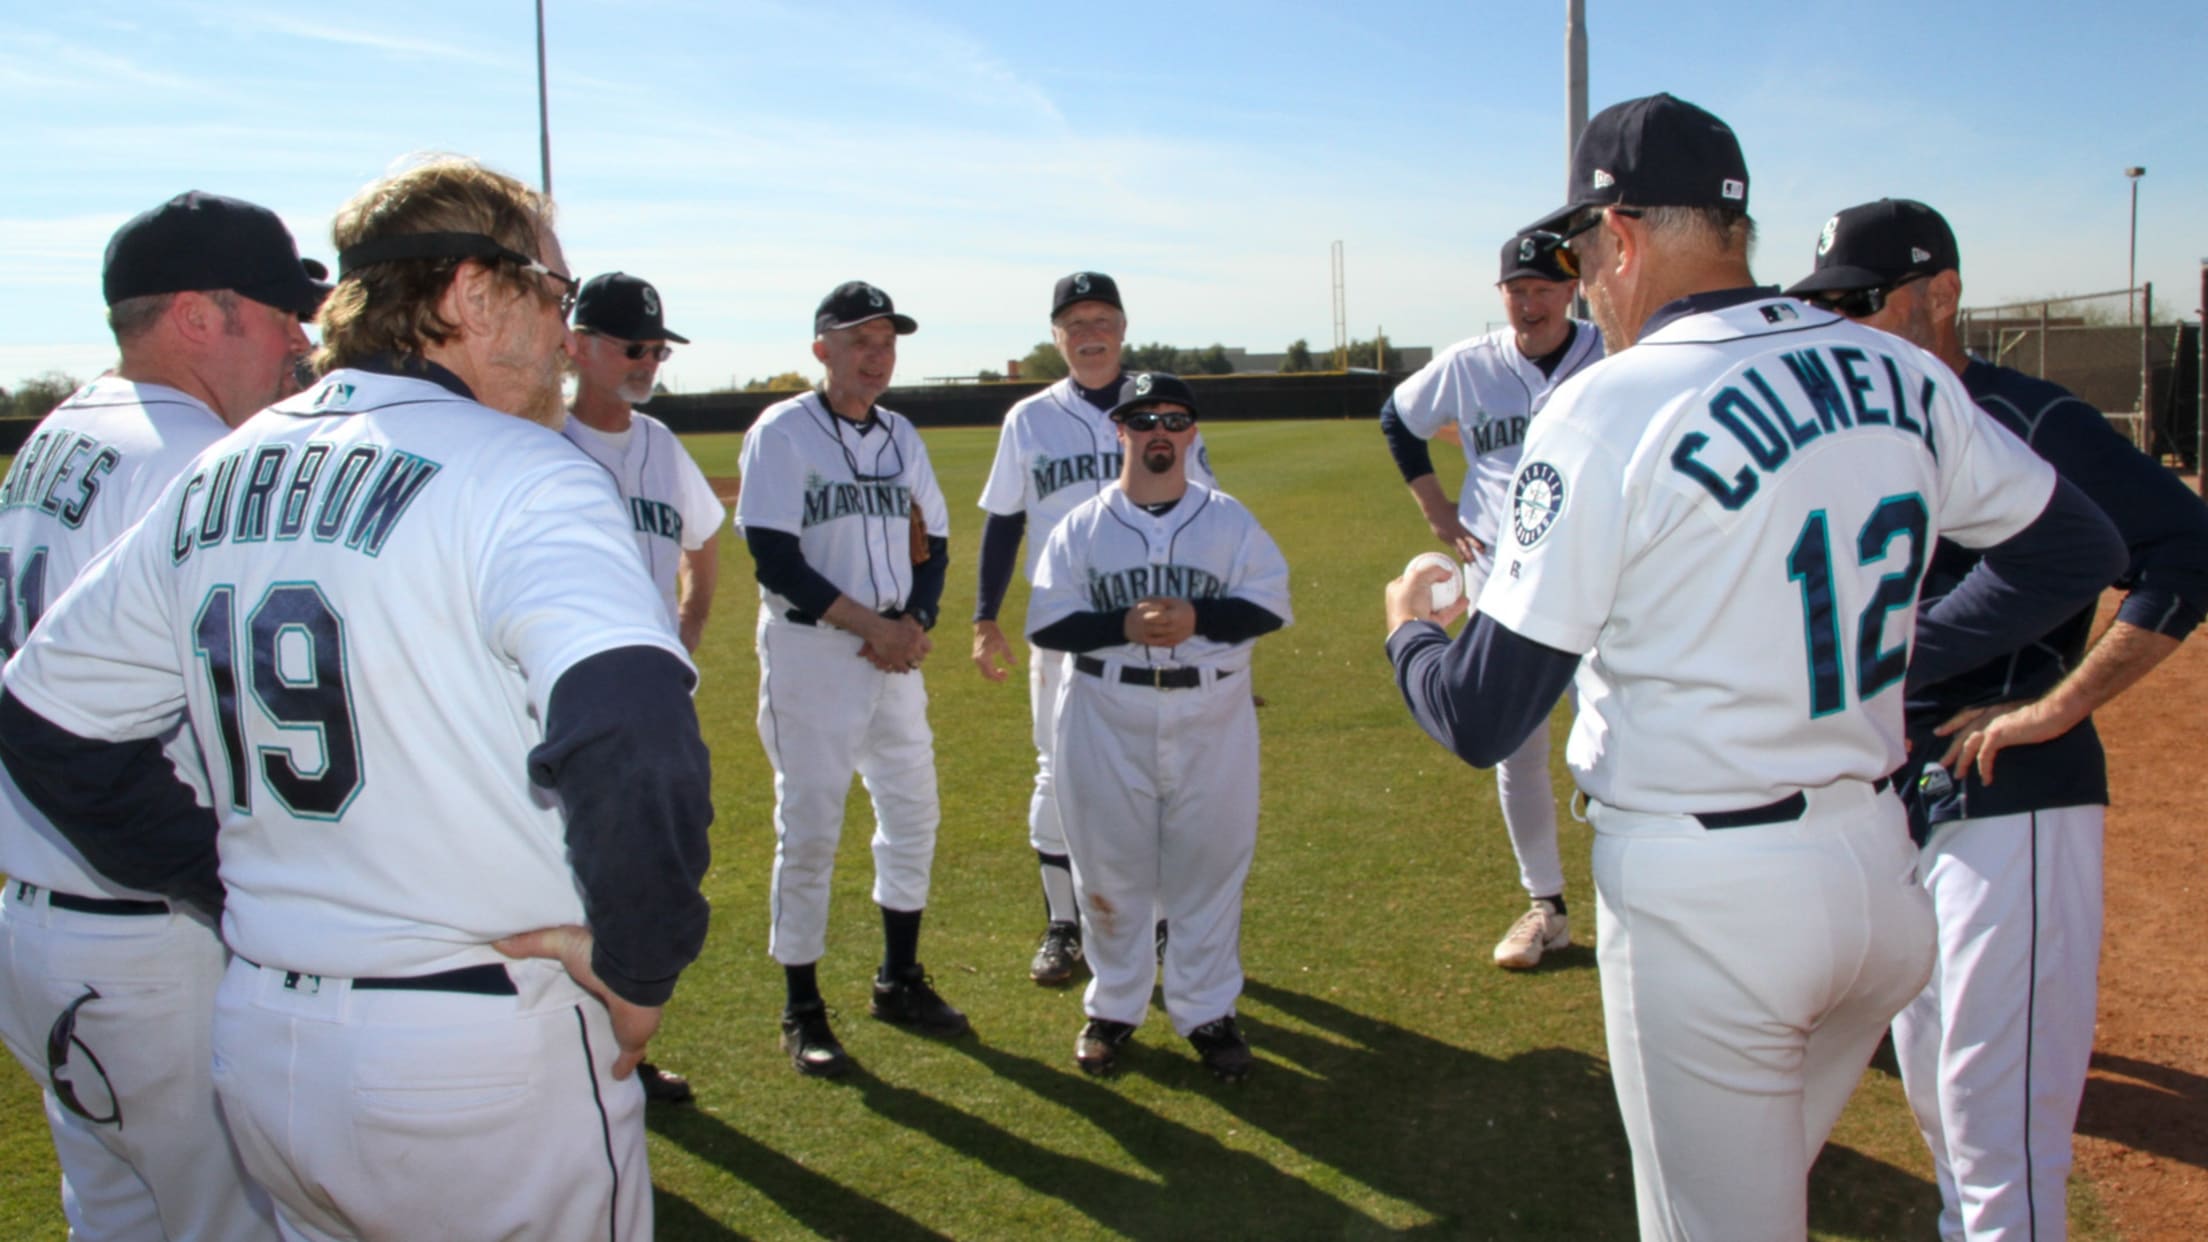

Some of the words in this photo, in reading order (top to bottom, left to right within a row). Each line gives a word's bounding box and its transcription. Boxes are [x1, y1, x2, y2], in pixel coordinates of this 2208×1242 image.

[1520, 237, 1535, 260] S
[1075, 273, 1090, 293] S
[643, 287, 658, 316] S
[1136, 373, 1152, 396] S
[1472, 414, 1530, 455] MAR
[171, 441, 442, 567] CURBOW
[1786, 491, 1929, 720] 12
[191, 580, 366, 823] 19
